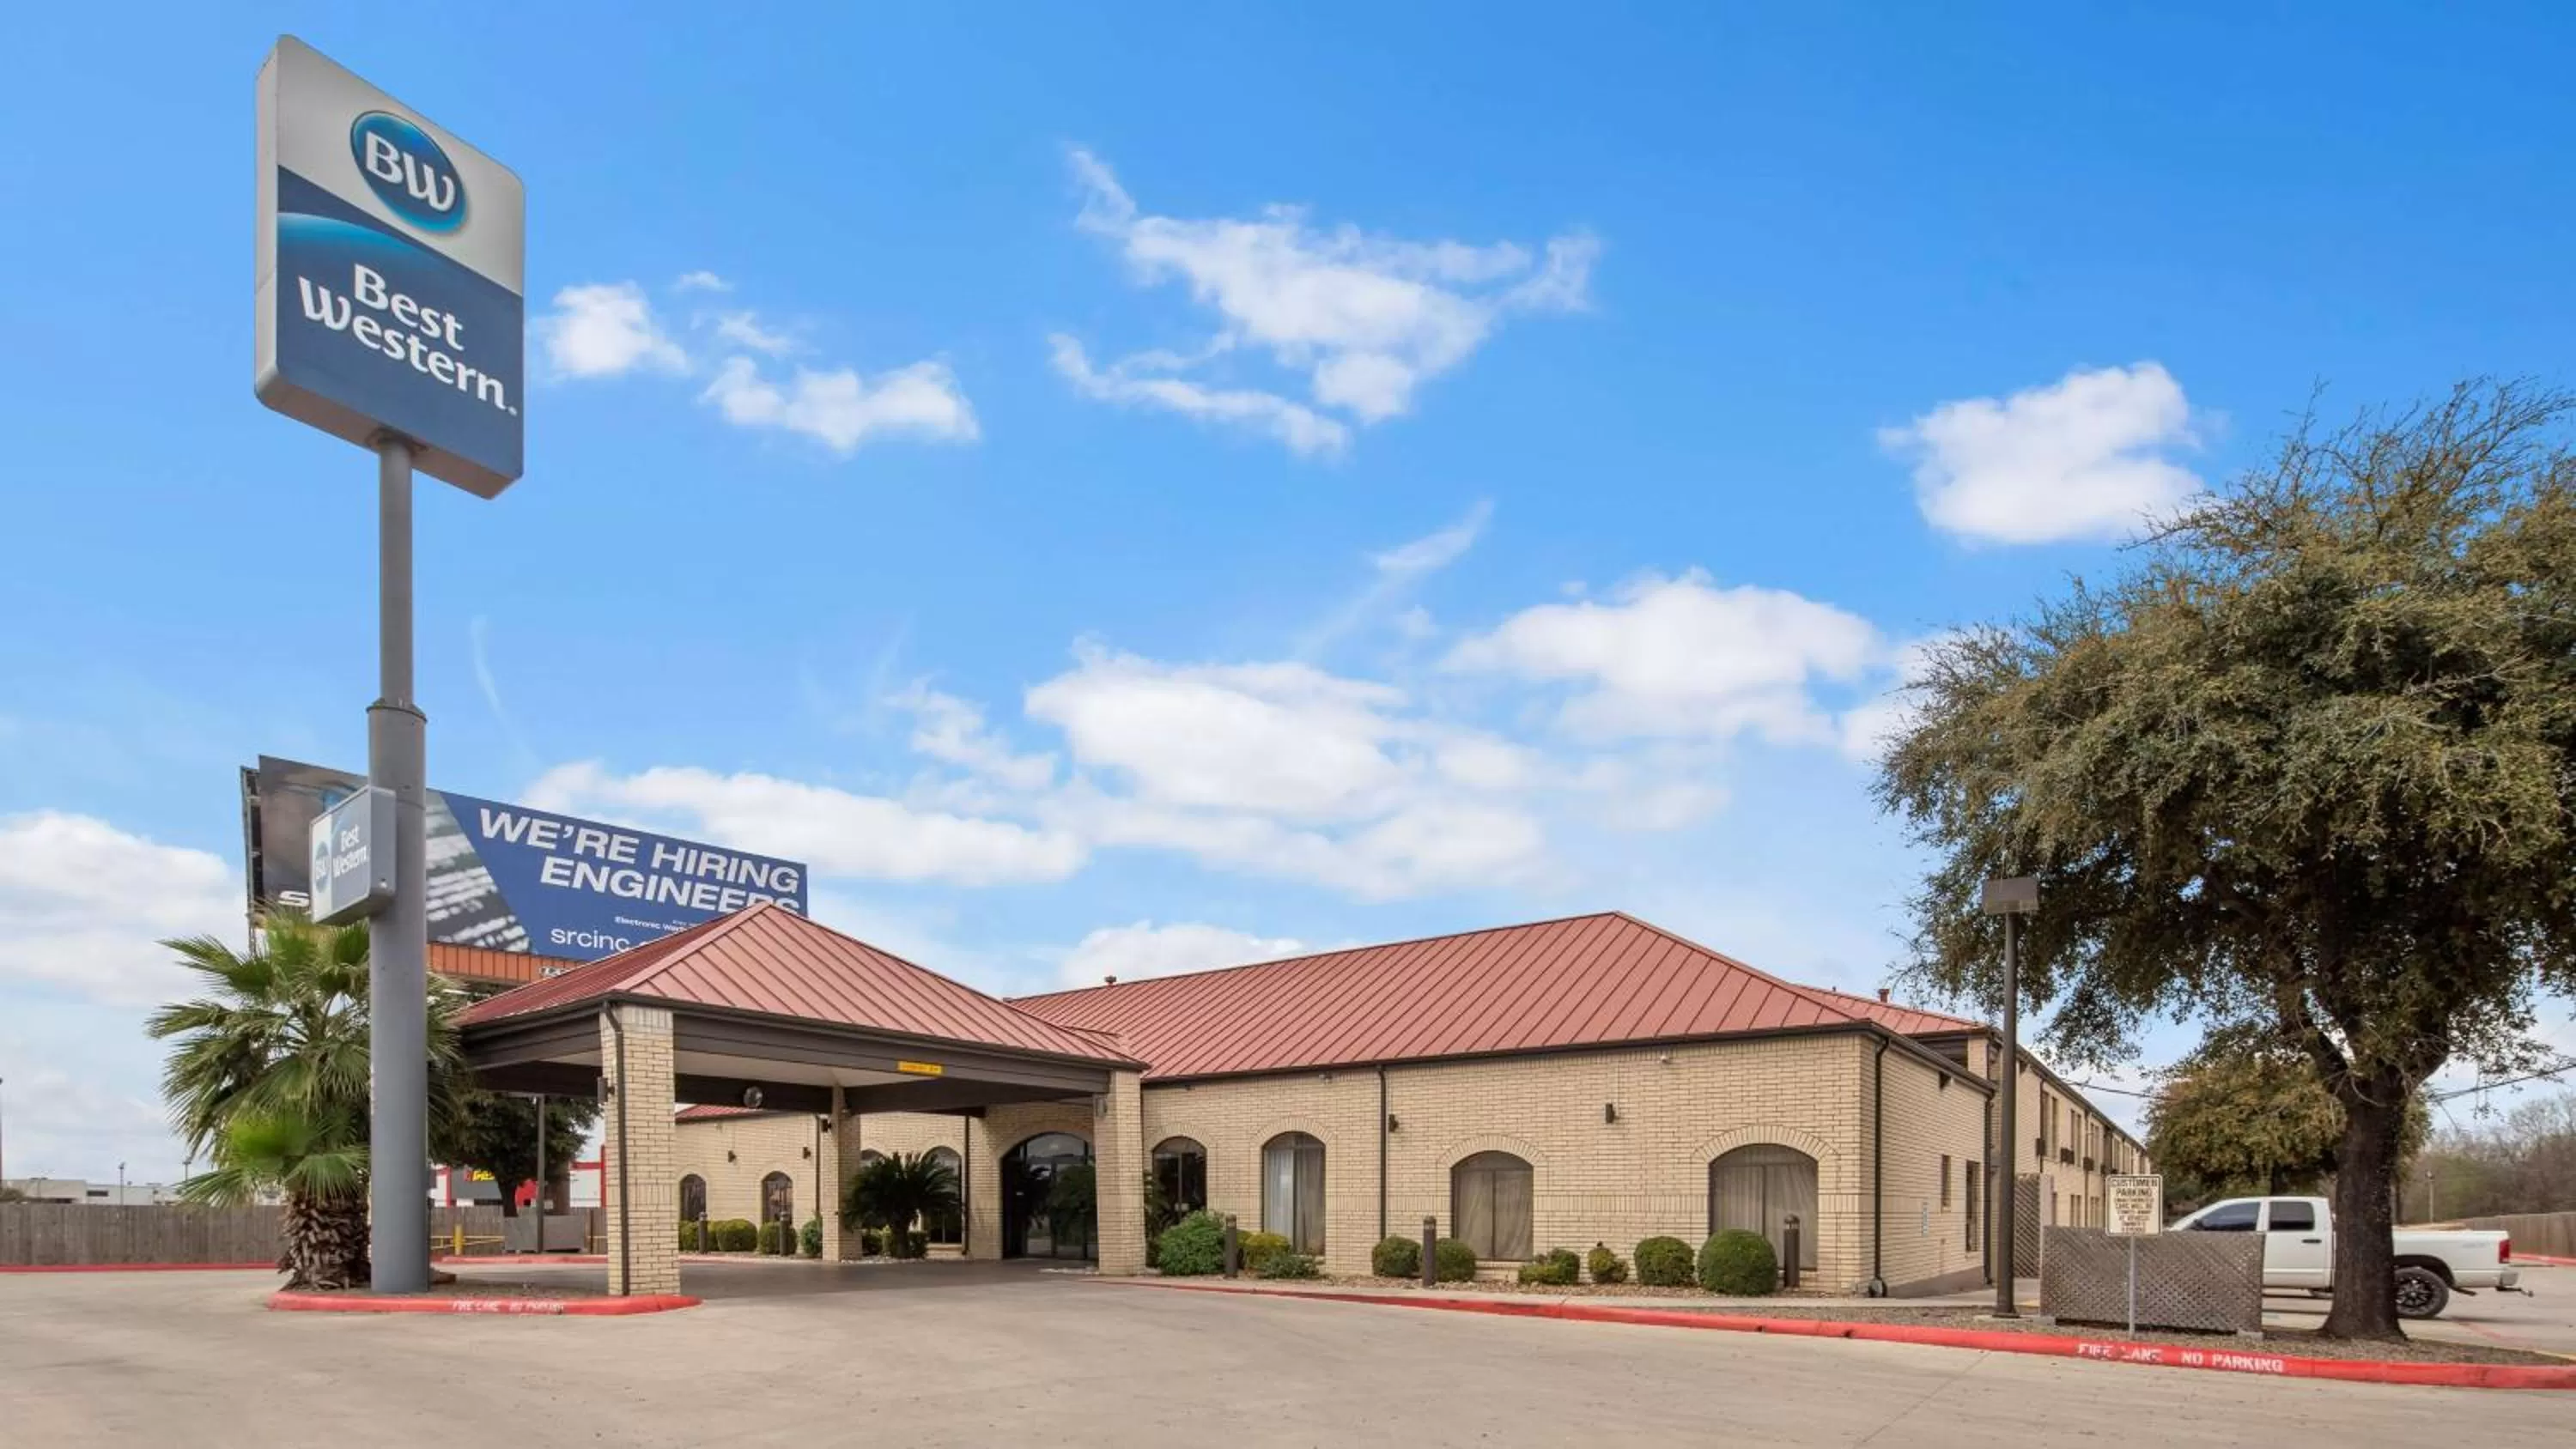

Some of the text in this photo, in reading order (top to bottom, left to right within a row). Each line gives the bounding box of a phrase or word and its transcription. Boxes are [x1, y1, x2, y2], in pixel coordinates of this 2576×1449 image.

[365, 131, 456, 212] BW
[354, 263, 465, 351] Best
[651, 842, 799, 894] HIRING
[615, 916, 661, 930] Electronic
[2116, 1187, 2153, 1197] PARKING
[2180, 1351, 2203, 1366] NO
[2212, 1352, 2285, 1373] PARKING
